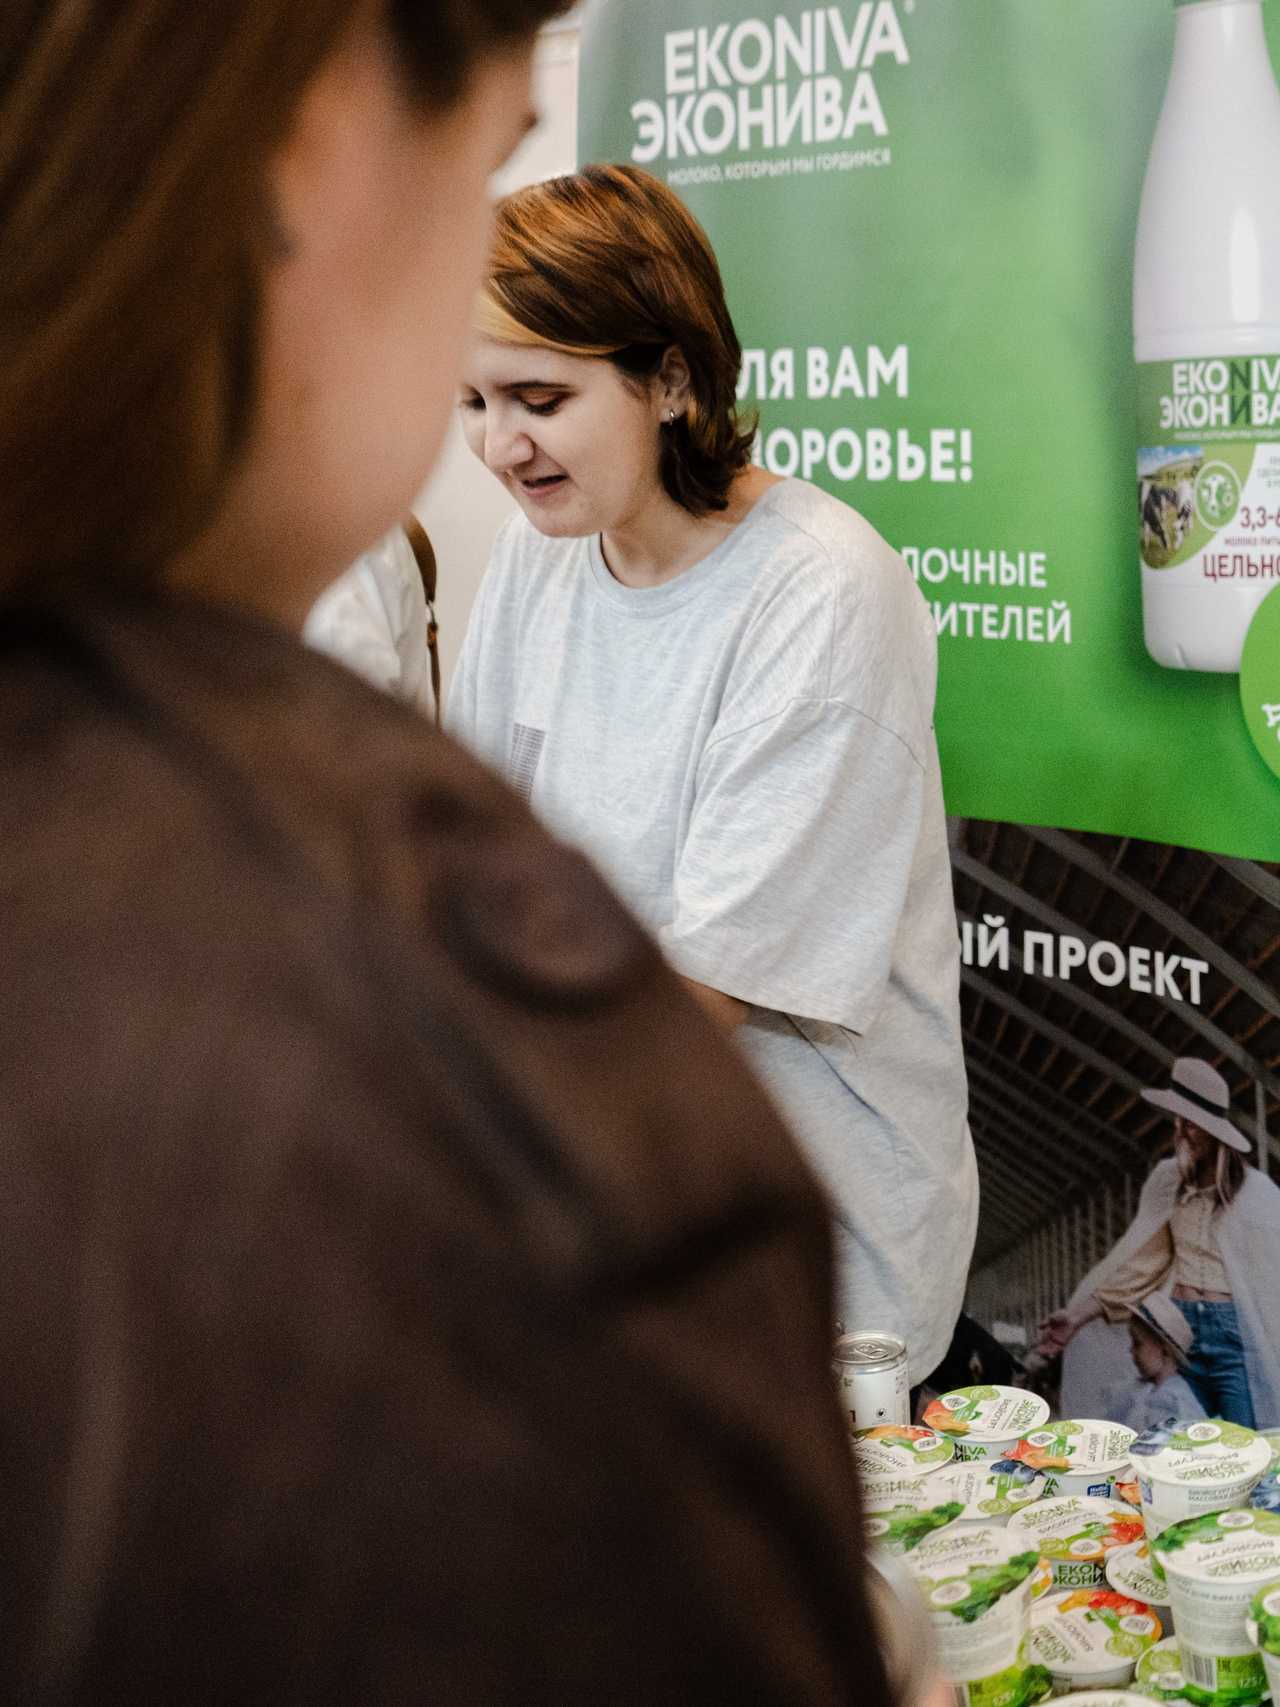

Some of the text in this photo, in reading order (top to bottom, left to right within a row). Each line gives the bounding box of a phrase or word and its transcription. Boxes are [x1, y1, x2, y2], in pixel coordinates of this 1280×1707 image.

[664, 0, 910, 95] EKONIVA
[631, 72, 888, 163] ЭКОНИВА
[806, 344, 909, 399] ВАМ
[750, 428, 973, 482] ОРОВЬЕ!
[927, 599, 1072, 645] ИТЕЛЕЙ
[1023, 929, 1209, 1006] ПРОЕКТ
